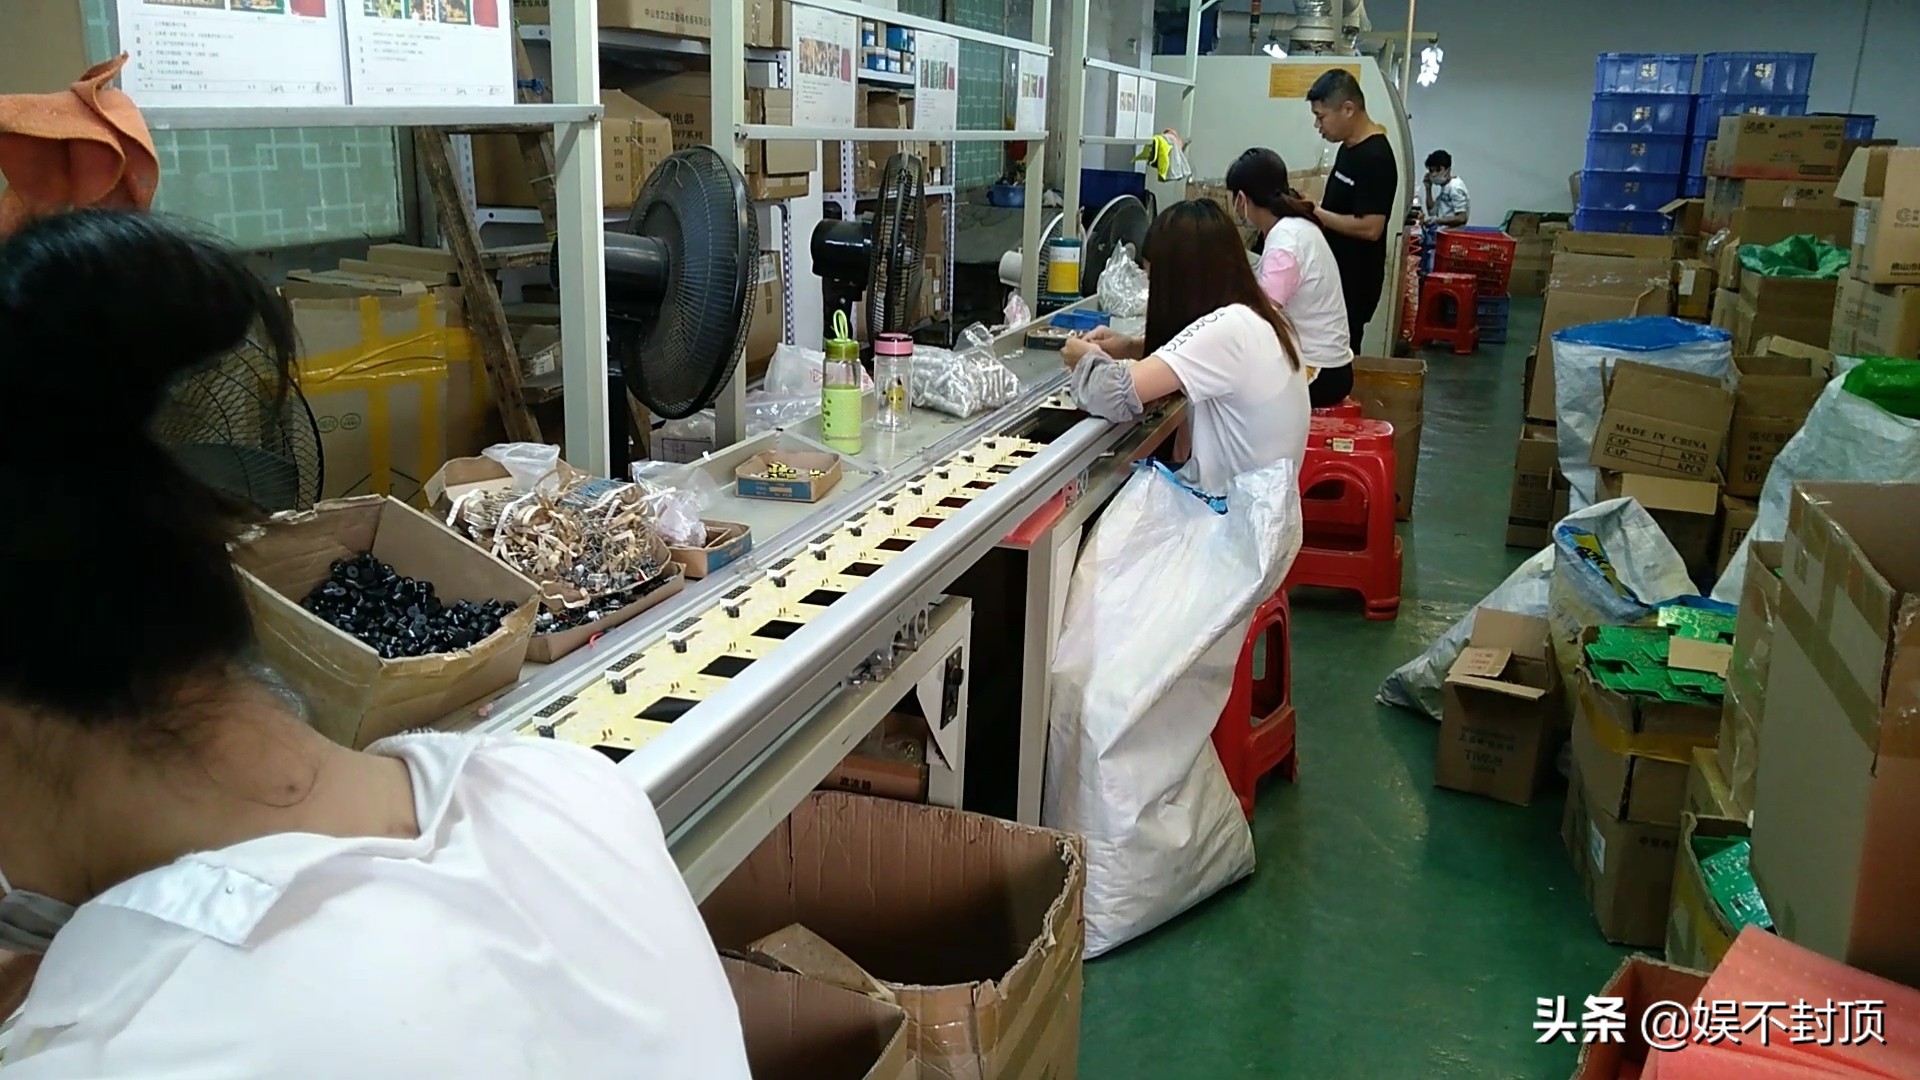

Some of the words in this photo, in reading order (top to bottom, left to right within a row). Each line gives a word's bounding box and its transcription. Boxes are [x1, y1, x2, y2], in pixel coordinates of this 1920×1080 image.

[1615, 423, 1647, 437] MADE
[1652, 432, 1667, 441] IN
[1671, 436, 1707, 450] CHINA
